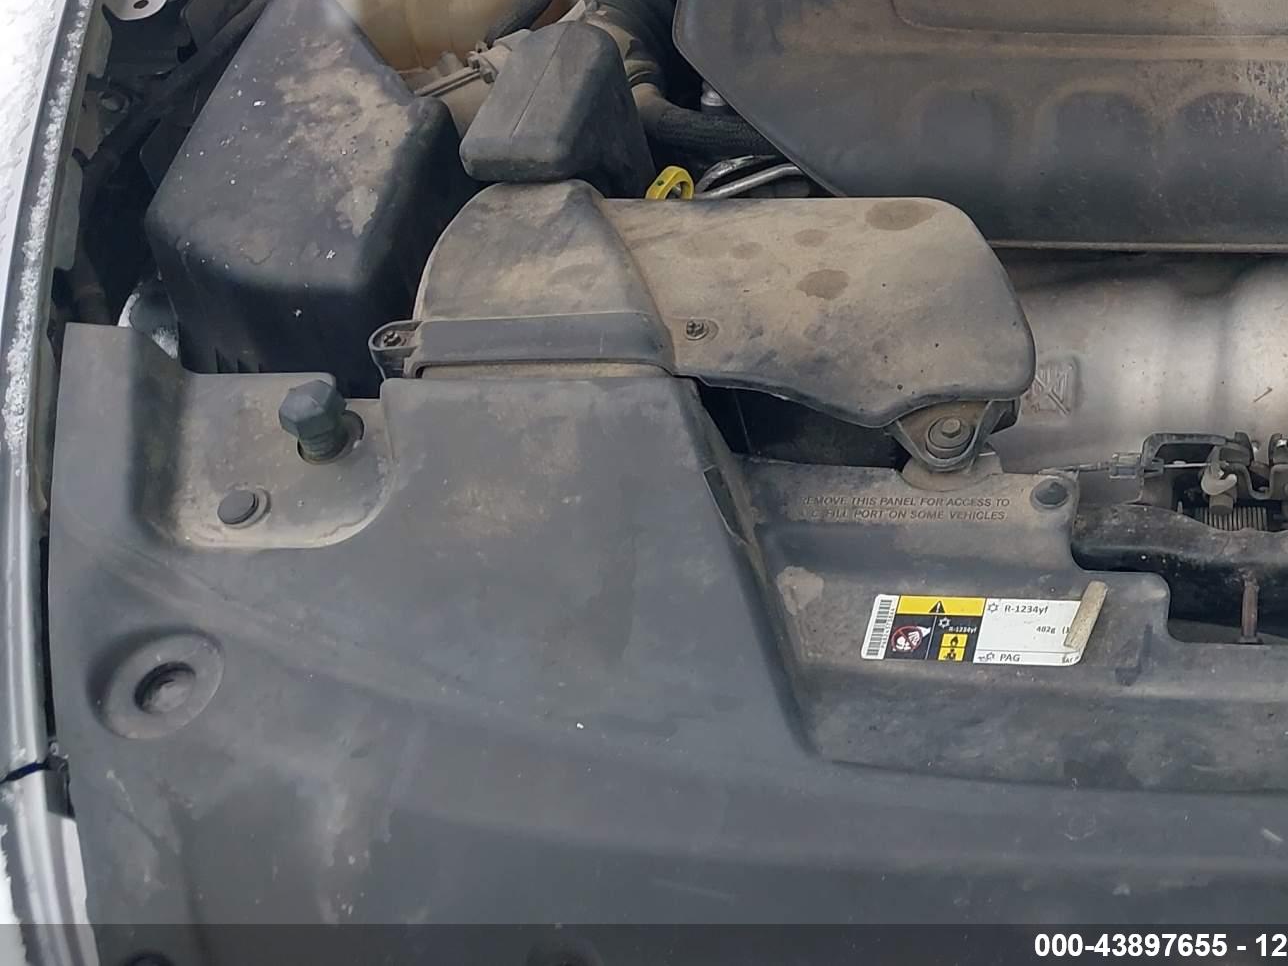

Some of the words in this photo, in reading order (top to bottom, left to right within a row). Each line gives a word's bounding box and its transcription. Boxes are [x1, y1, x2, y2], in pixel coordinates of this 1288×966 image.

[851, 496, 877, 507] THIS
[879, 497, 916, 507] PANEL
[919, 497, 944, 507] FOR
[945, 497, 992, 507] ACCESS
[995, 497, 1011, 507] TO
[853, 509, 884, 519] PORT
[888, 509, 907, 519] ON
[910, 509, 945, 520] SOME
[1004, 605, 1049, 614] R-1234yf
[1000, 653, 1021, 662] PAG
